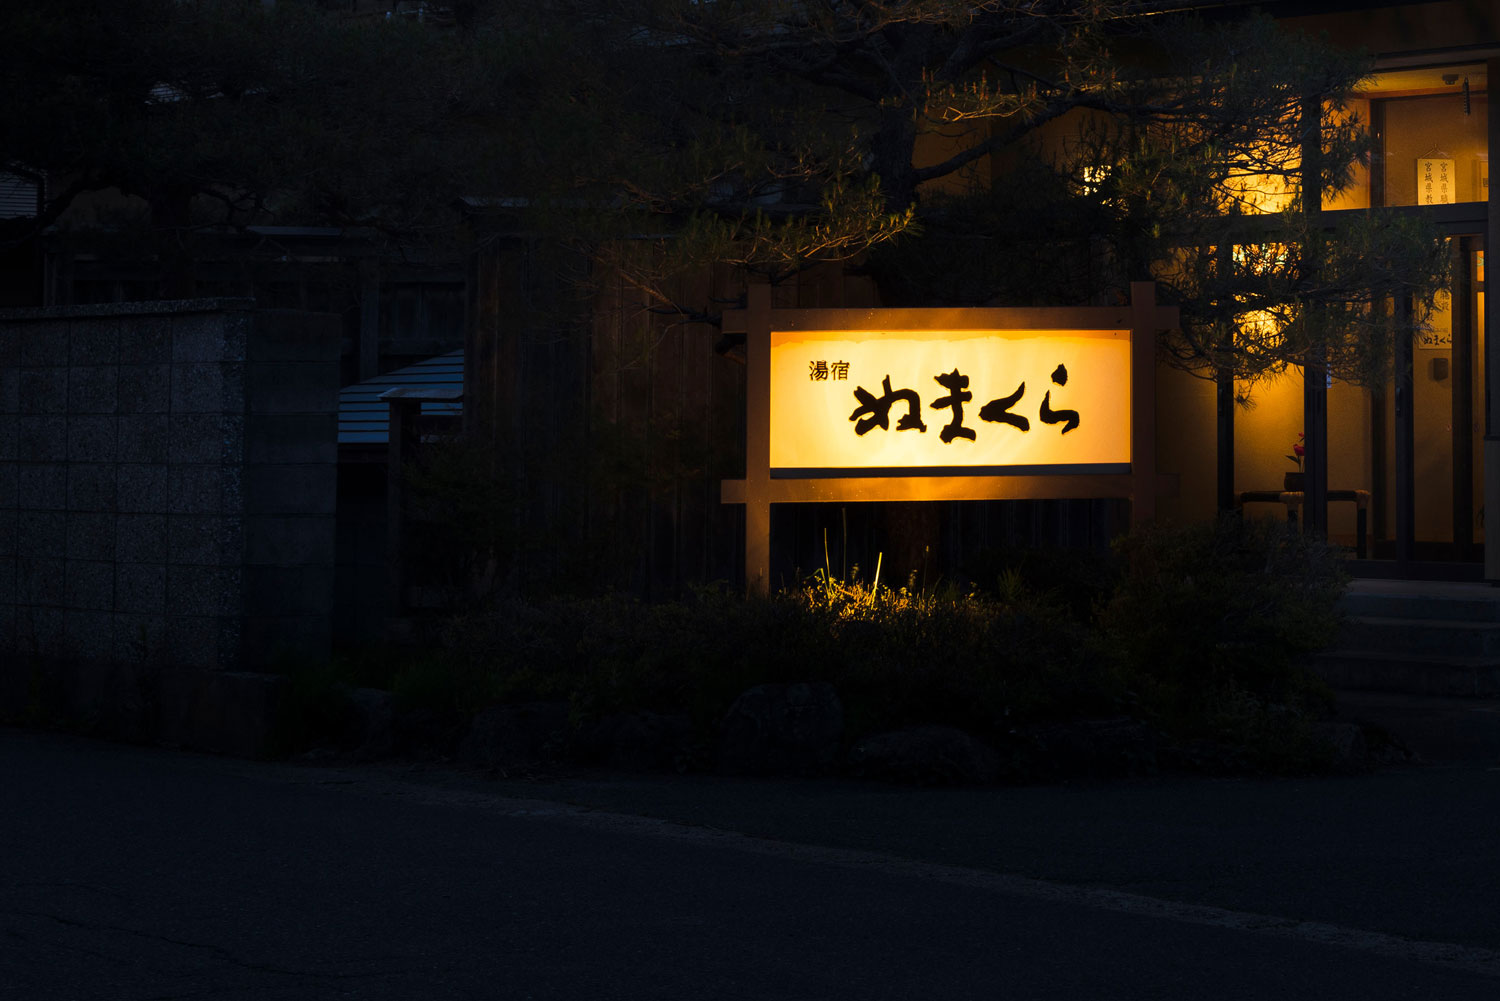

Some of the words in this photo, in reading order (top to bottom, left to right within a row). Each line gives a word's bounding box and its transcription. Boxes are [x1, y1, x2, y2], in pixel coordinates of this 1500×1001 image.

[809, 360, 850, 381] 湯宿
[849, 363, 1080, 444] ぬまくら
